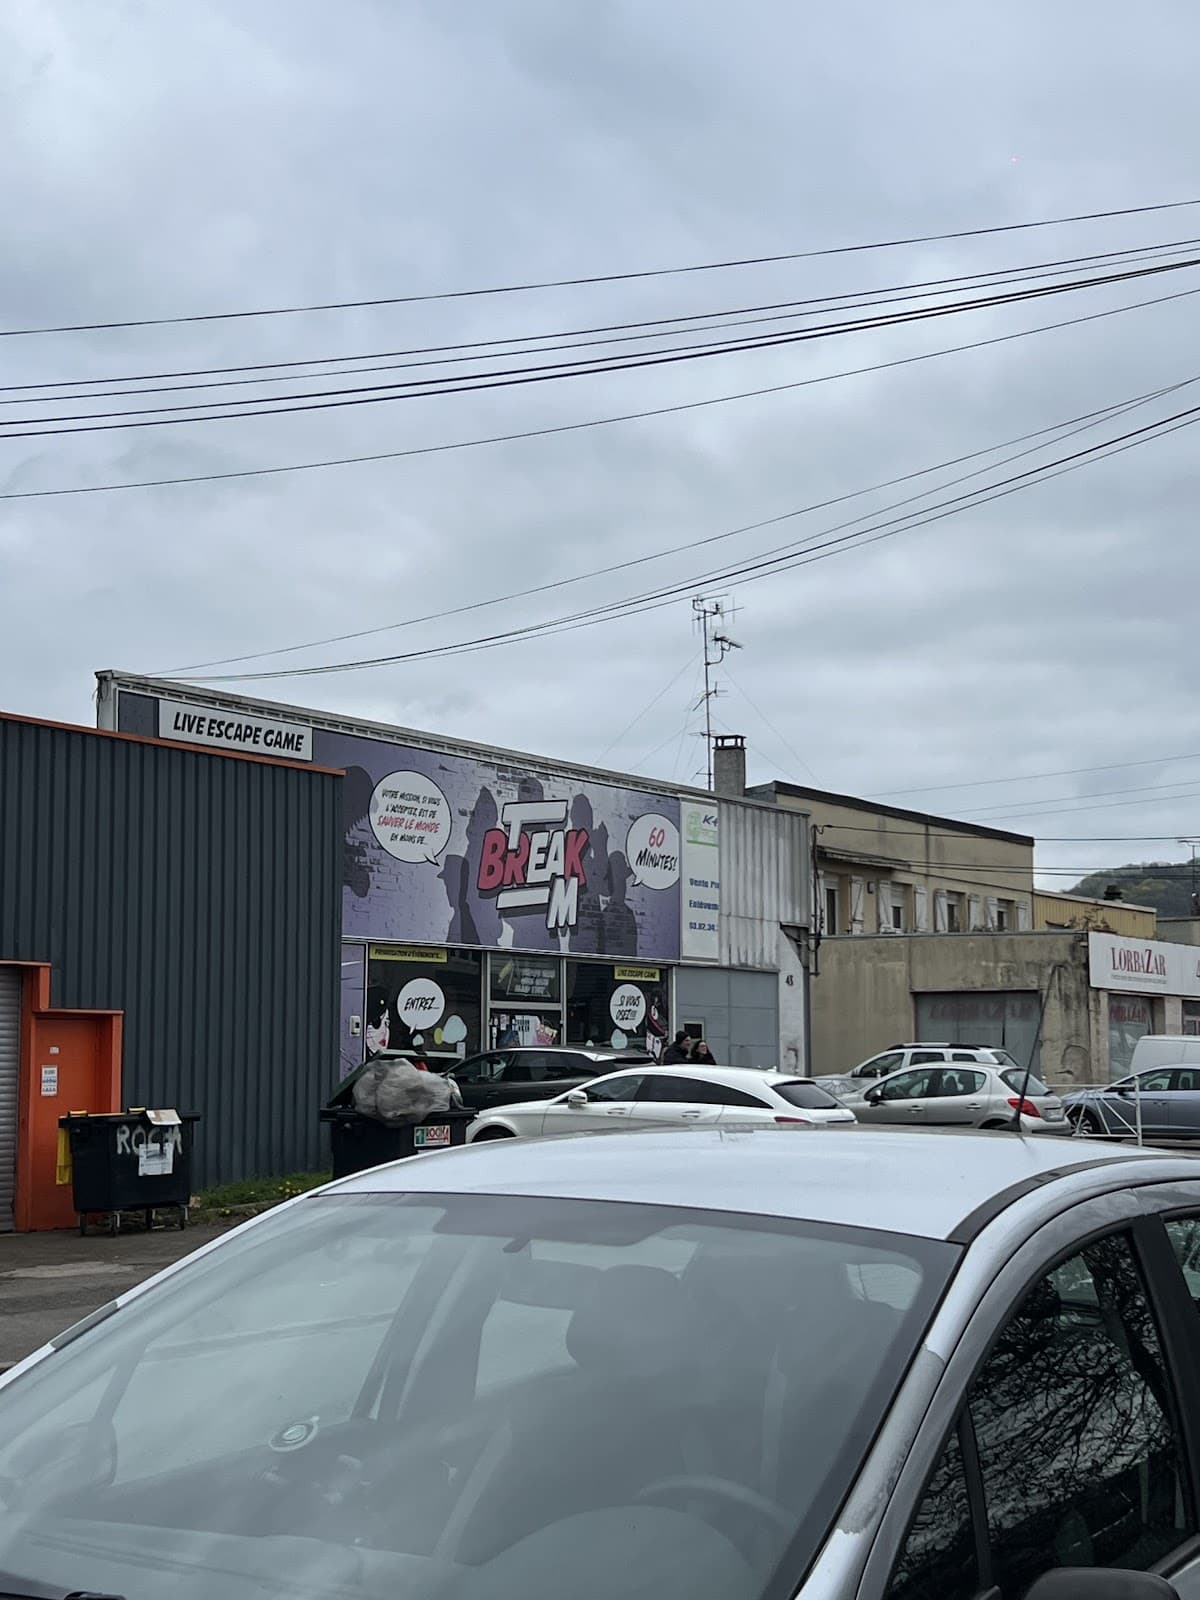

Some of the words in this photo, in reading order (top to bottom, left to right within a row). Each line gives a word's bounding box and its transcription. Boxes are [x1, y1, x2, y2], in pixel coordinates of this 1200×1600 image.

[173, 712, 206, 735] LIVE
[206, 718, 262, 745] ESCAPE
[263, 729, 305, 752] GAME
[382, 789, 400, 798] VOTRE
[422, 796, 428, 804] SI
[428, 798, 441, 806] VOUS
[419, 808, 429, 818] EST
[429, 810, 438, 819] DE
[377, 815, 405, 829] SAUVER
[404, 818, 415, 830] LE
[415, 820, 441, 833] MONDE
[390, 832, 399, 842] EN
[400, 833, 417, 844] MOINS
[648, 827, 665, 848] 60
[477, 827, 589, 891] BREAK
[635, 848, 678, 872] MINUTES!
[1111, 947, 1166, 976] LORBAZAR
[644, 971, 657, 979] GAME
[626, 995, 641, 1007] VOUS
